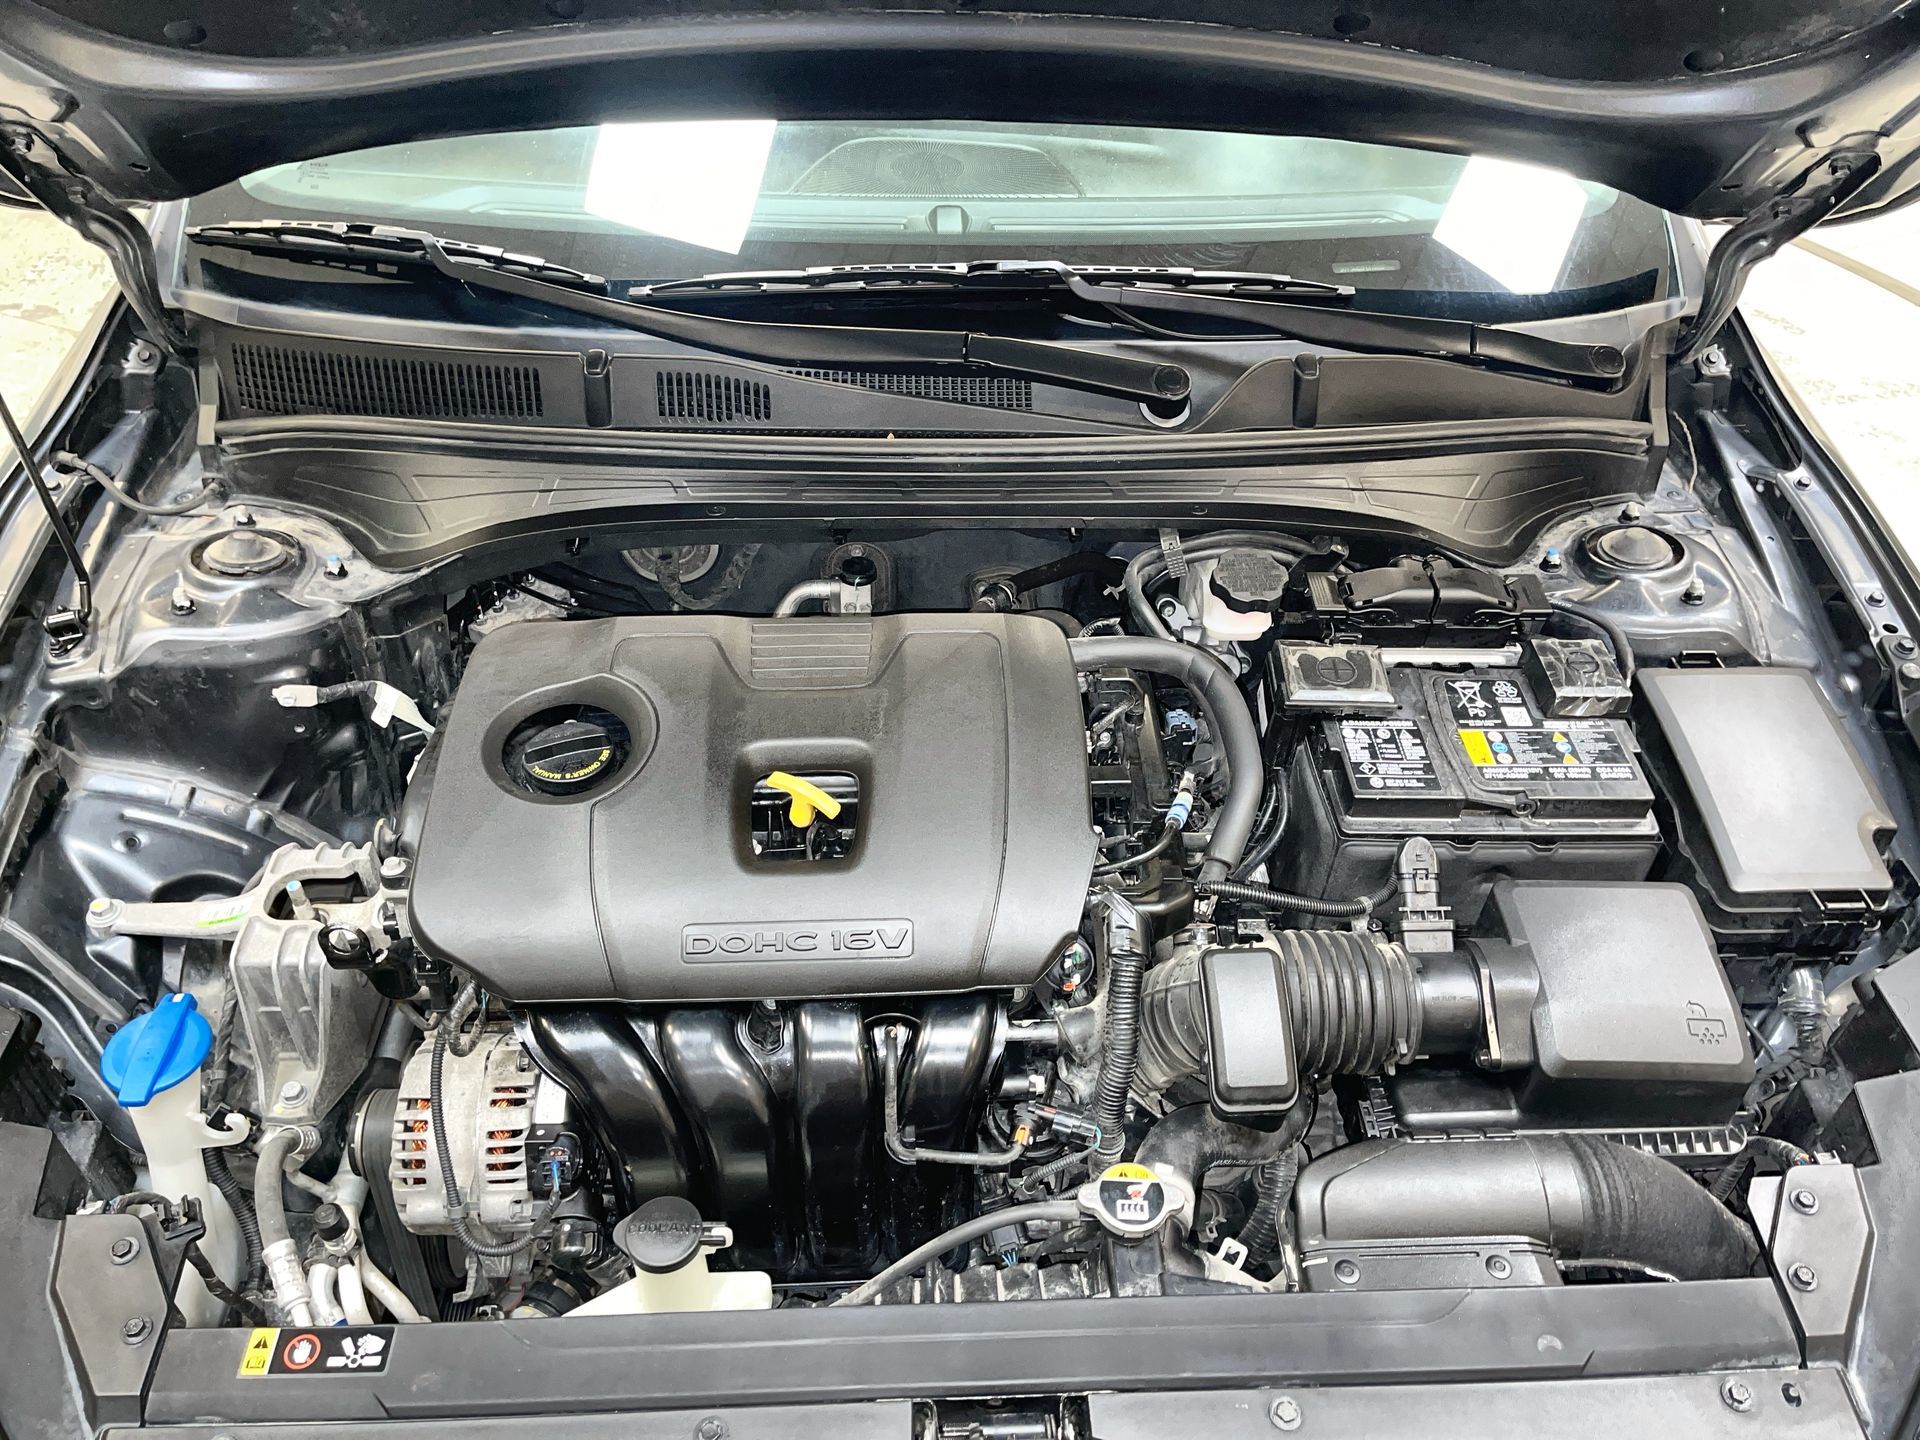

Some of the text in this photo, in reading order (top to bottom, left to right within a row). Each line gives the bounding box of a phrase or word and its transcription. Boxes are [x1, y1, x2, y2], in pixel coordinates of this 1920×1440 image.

[1467, 708, 1487, 718] Pb
[532, 749, 610, 779] SEE OWNER'S MANUAL
[685, 928, 908, 955] DOHC 16V
[628, 1222, 701, 1235] COOLANT
